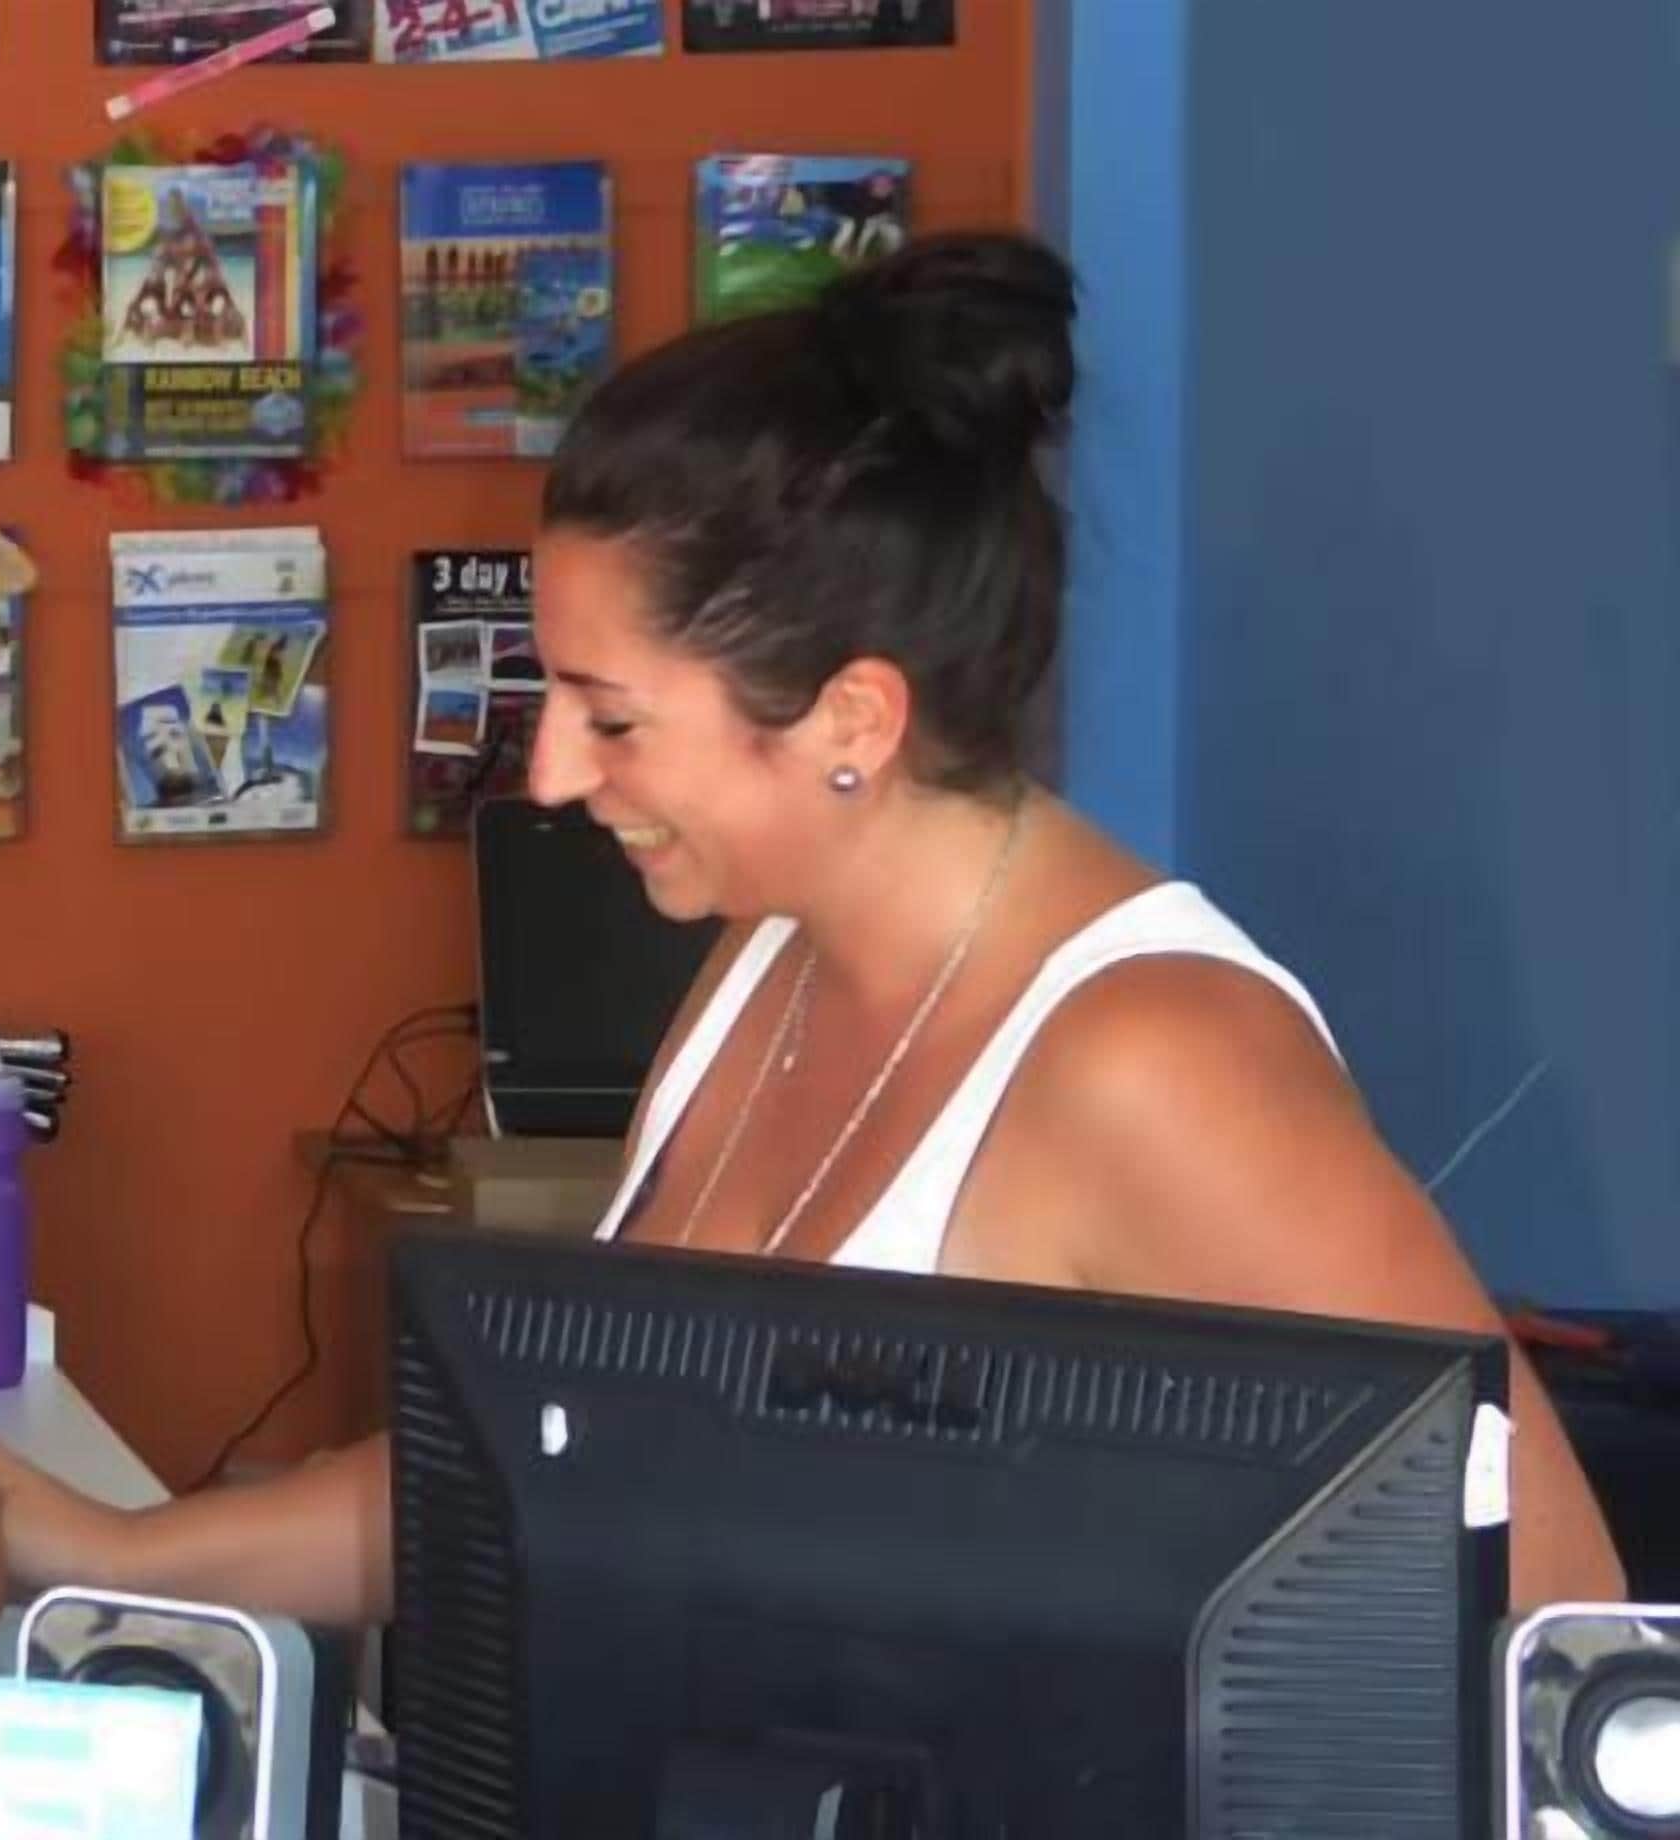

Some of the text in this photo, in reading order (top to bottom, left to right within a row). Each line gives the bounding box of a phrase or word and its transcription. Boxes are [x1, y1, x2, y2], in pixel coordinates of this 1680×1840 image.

[239, 367, 302, 391] BEACH
[432, 555, 452, 592] 3
[460, 555, 509, 596] day
